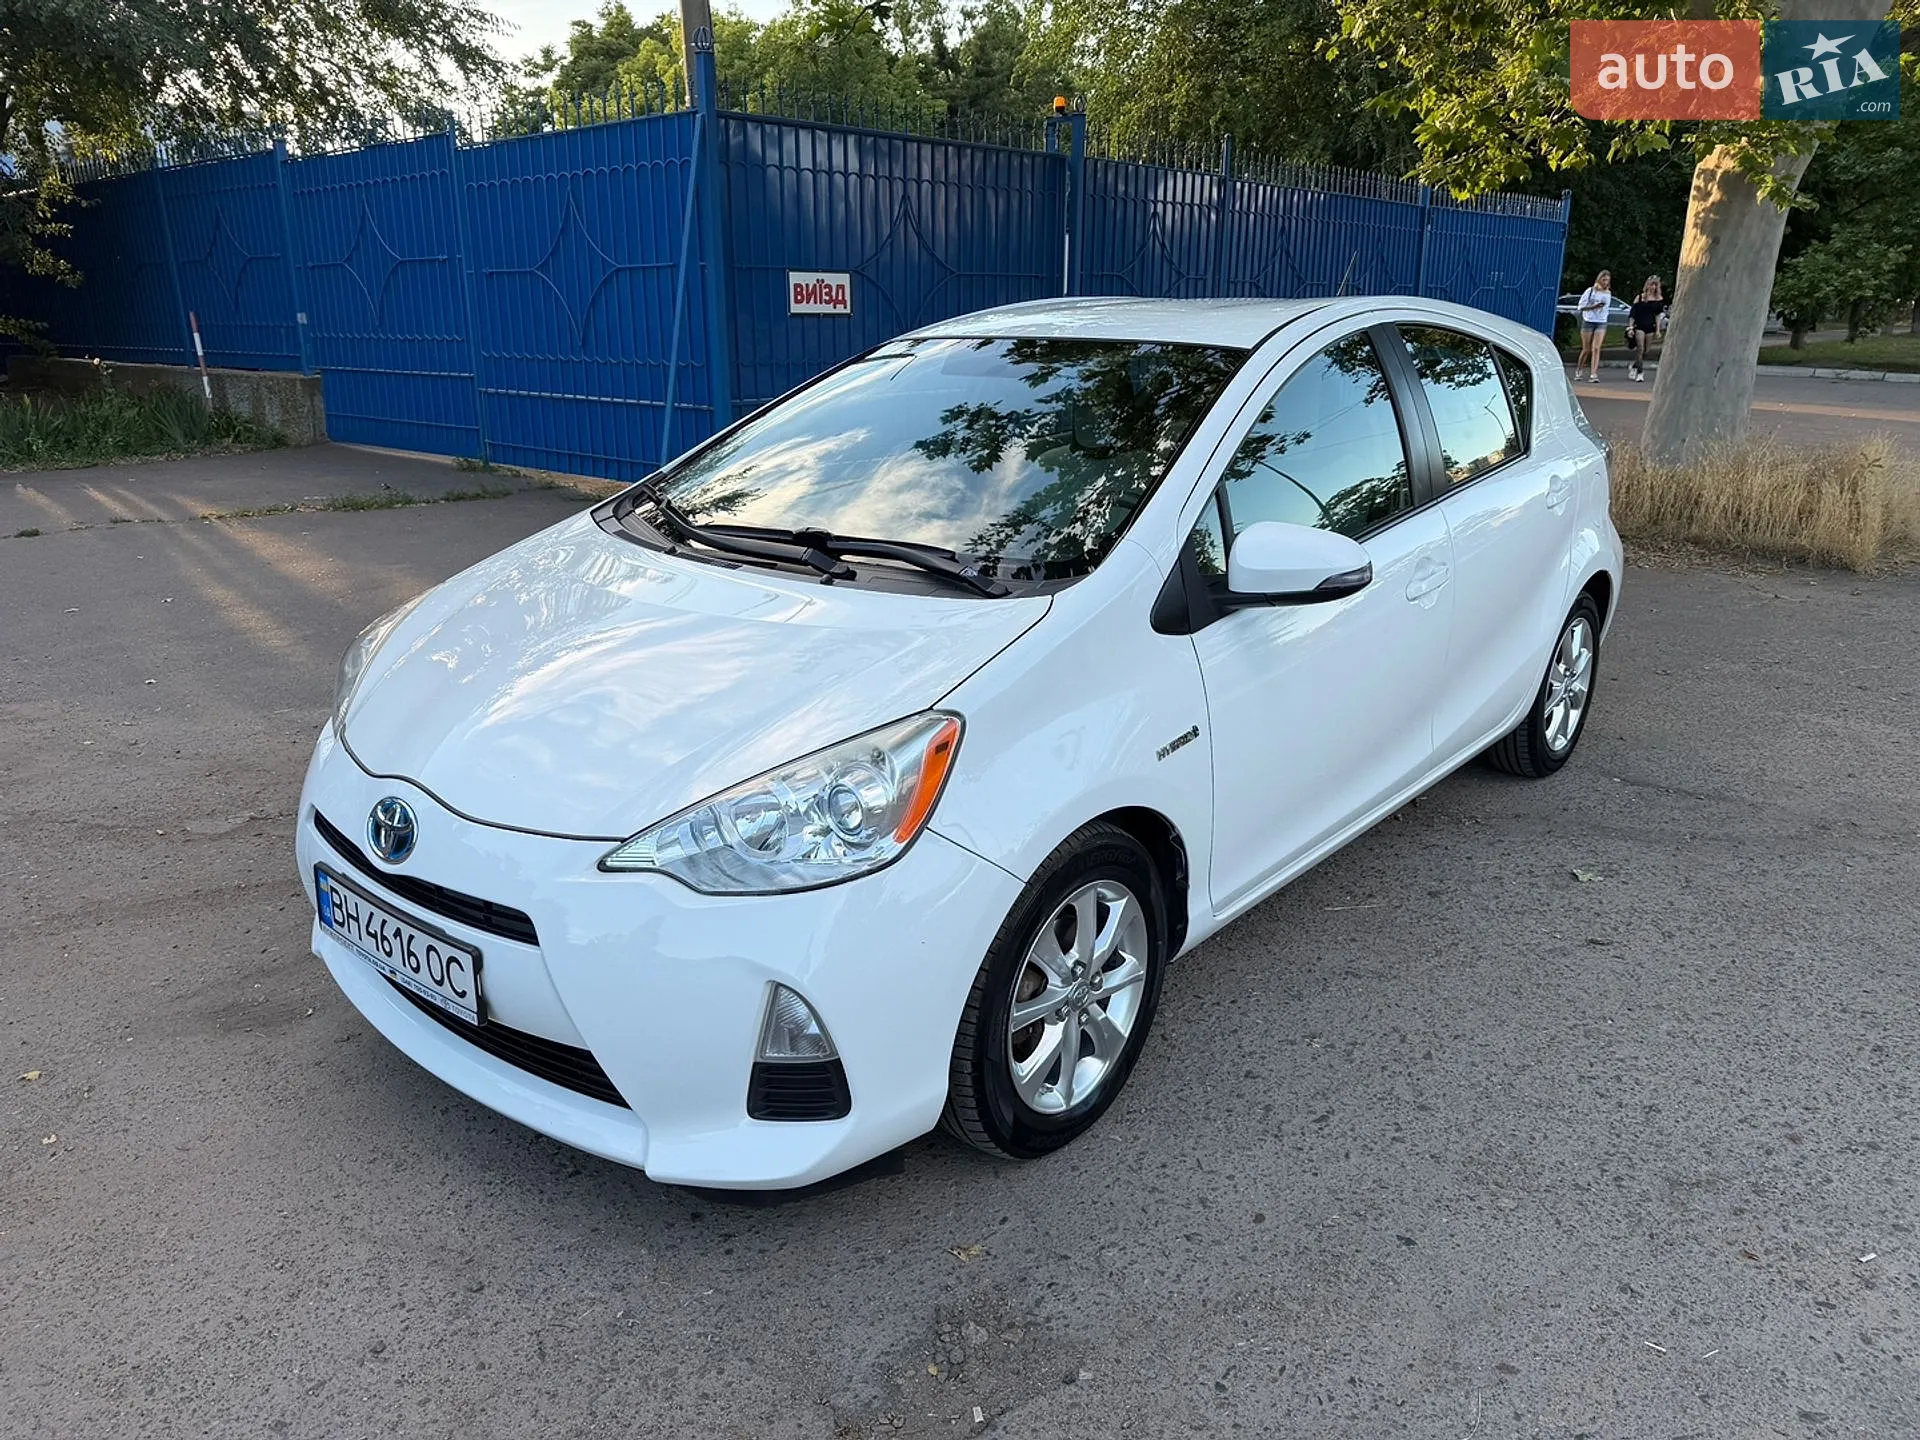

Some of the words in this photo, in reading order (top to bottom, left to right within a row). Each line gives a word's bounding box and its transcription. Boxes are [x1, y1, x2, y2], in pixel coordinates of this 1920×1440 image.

[793, 278, 848, 309] ВИЇЗД
[329, 884, 362, 941] BH
[365, 911, 421, 975] 4616
[426, 944, 467, 998] OC
